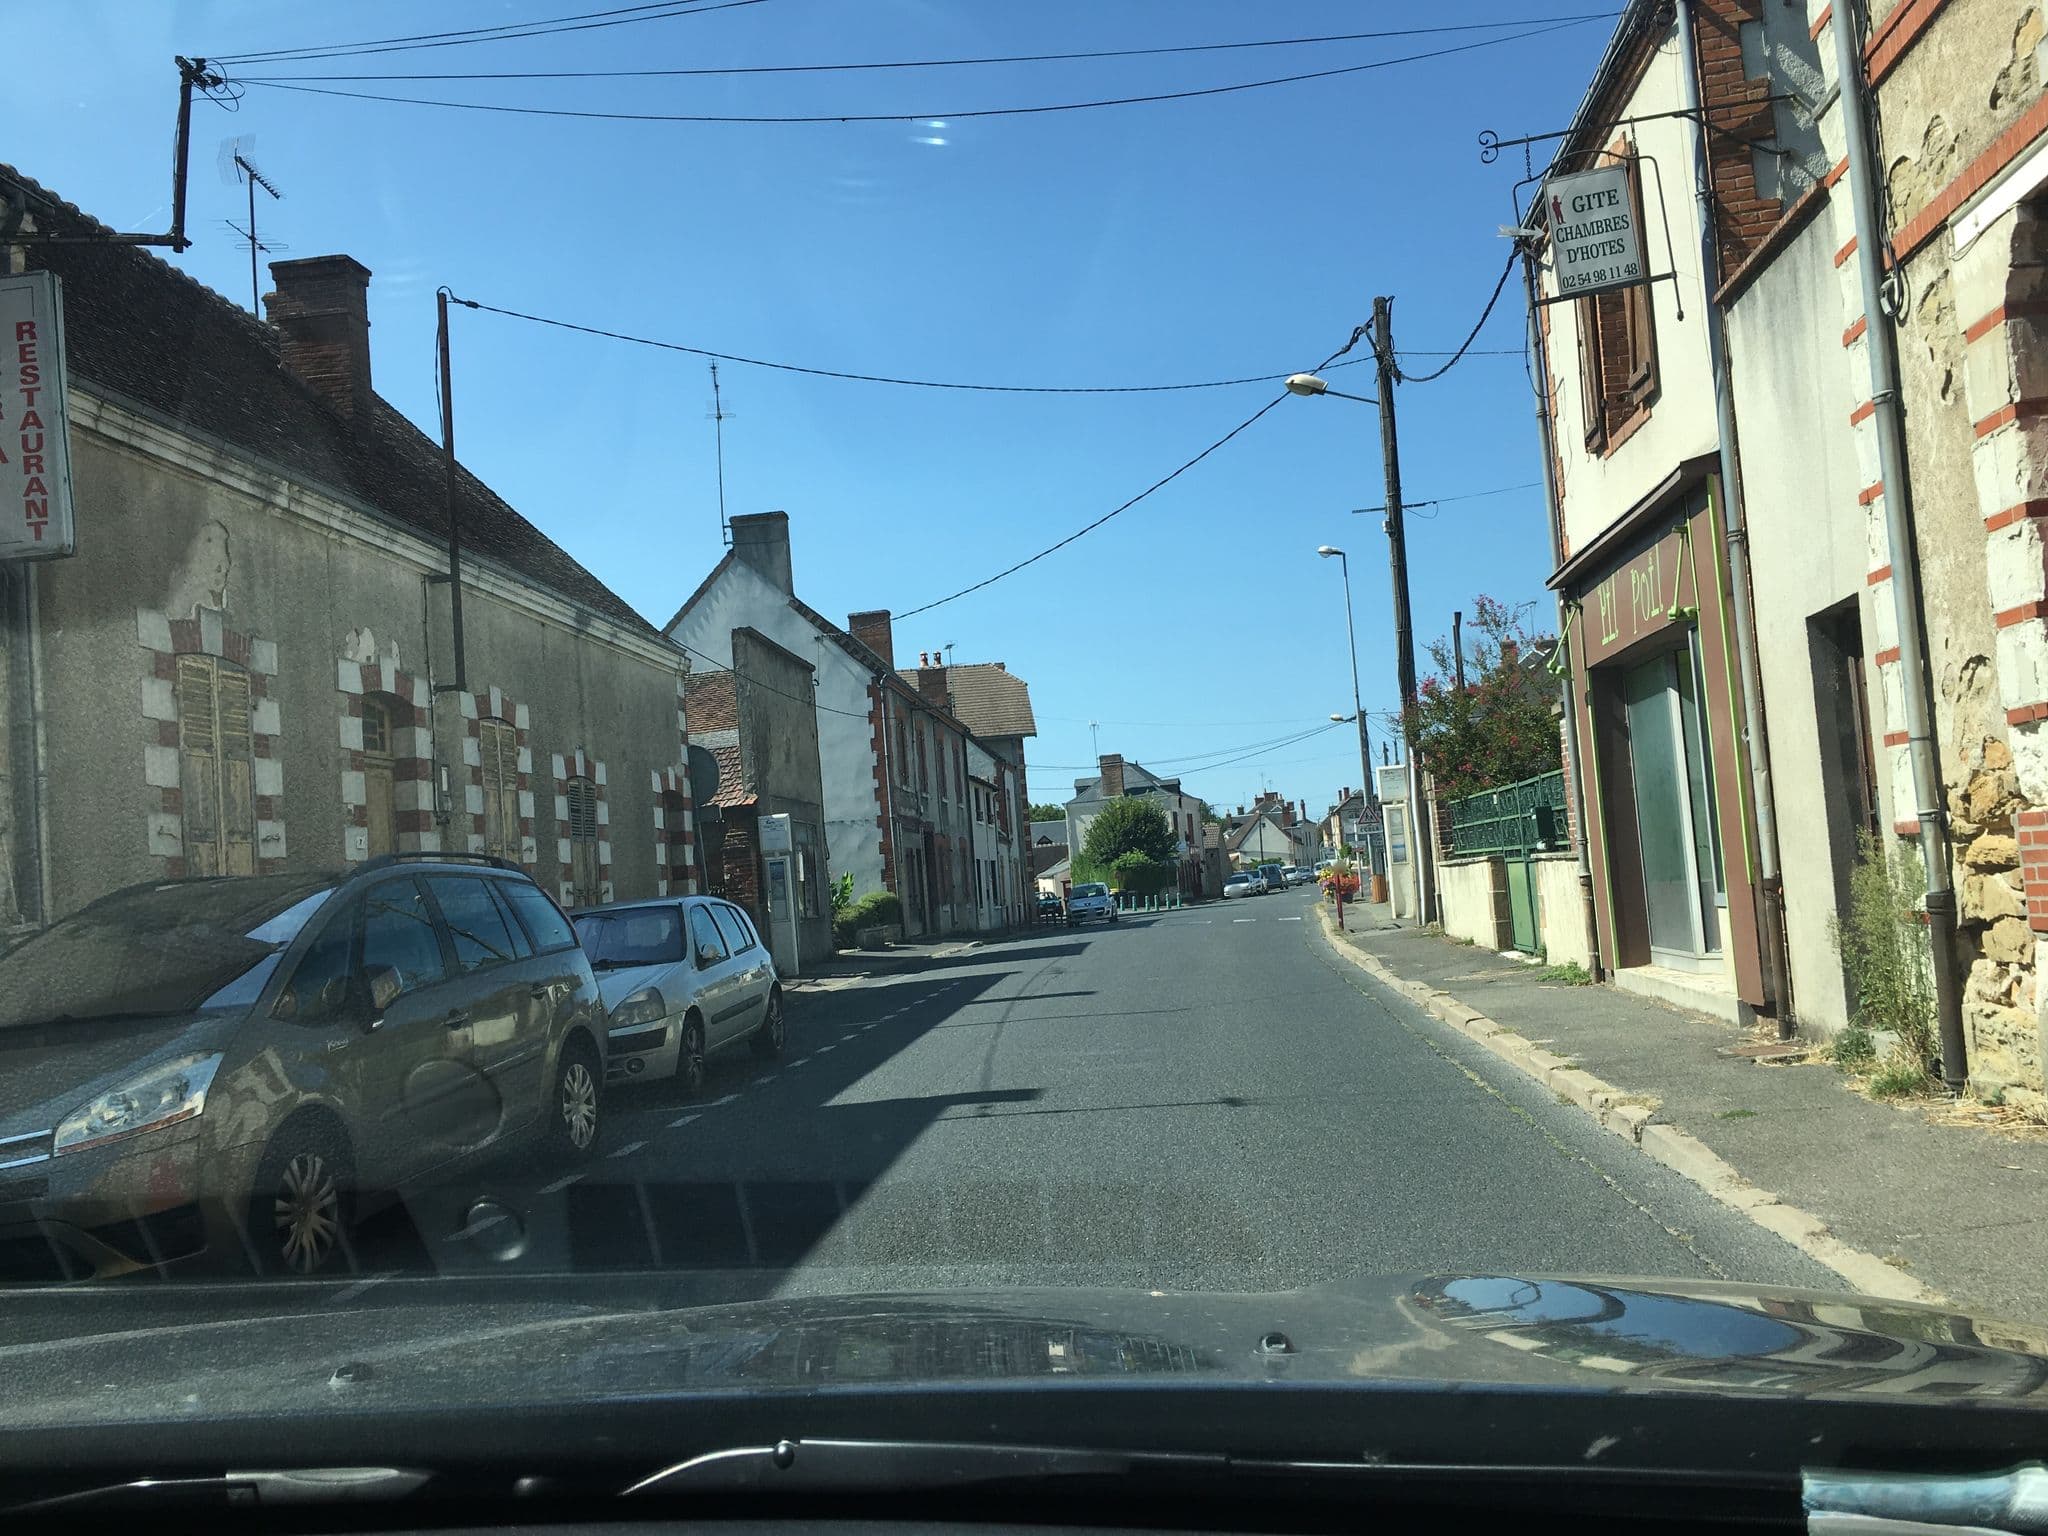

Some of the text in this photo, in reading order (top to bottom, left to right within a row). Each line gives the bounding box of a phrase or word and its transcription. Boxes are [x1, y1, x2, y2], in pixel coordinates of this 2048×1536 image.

[1572, 189, 1619, 213] GITE
[1556, 214, 1630, 243] CHAMBRES
[1567, 238, 1626, 264] D'HOTES
[1562, 262, 1638, 289] 02 54 98 11 48
[15, 321, 48, 541] RESTAURANT
